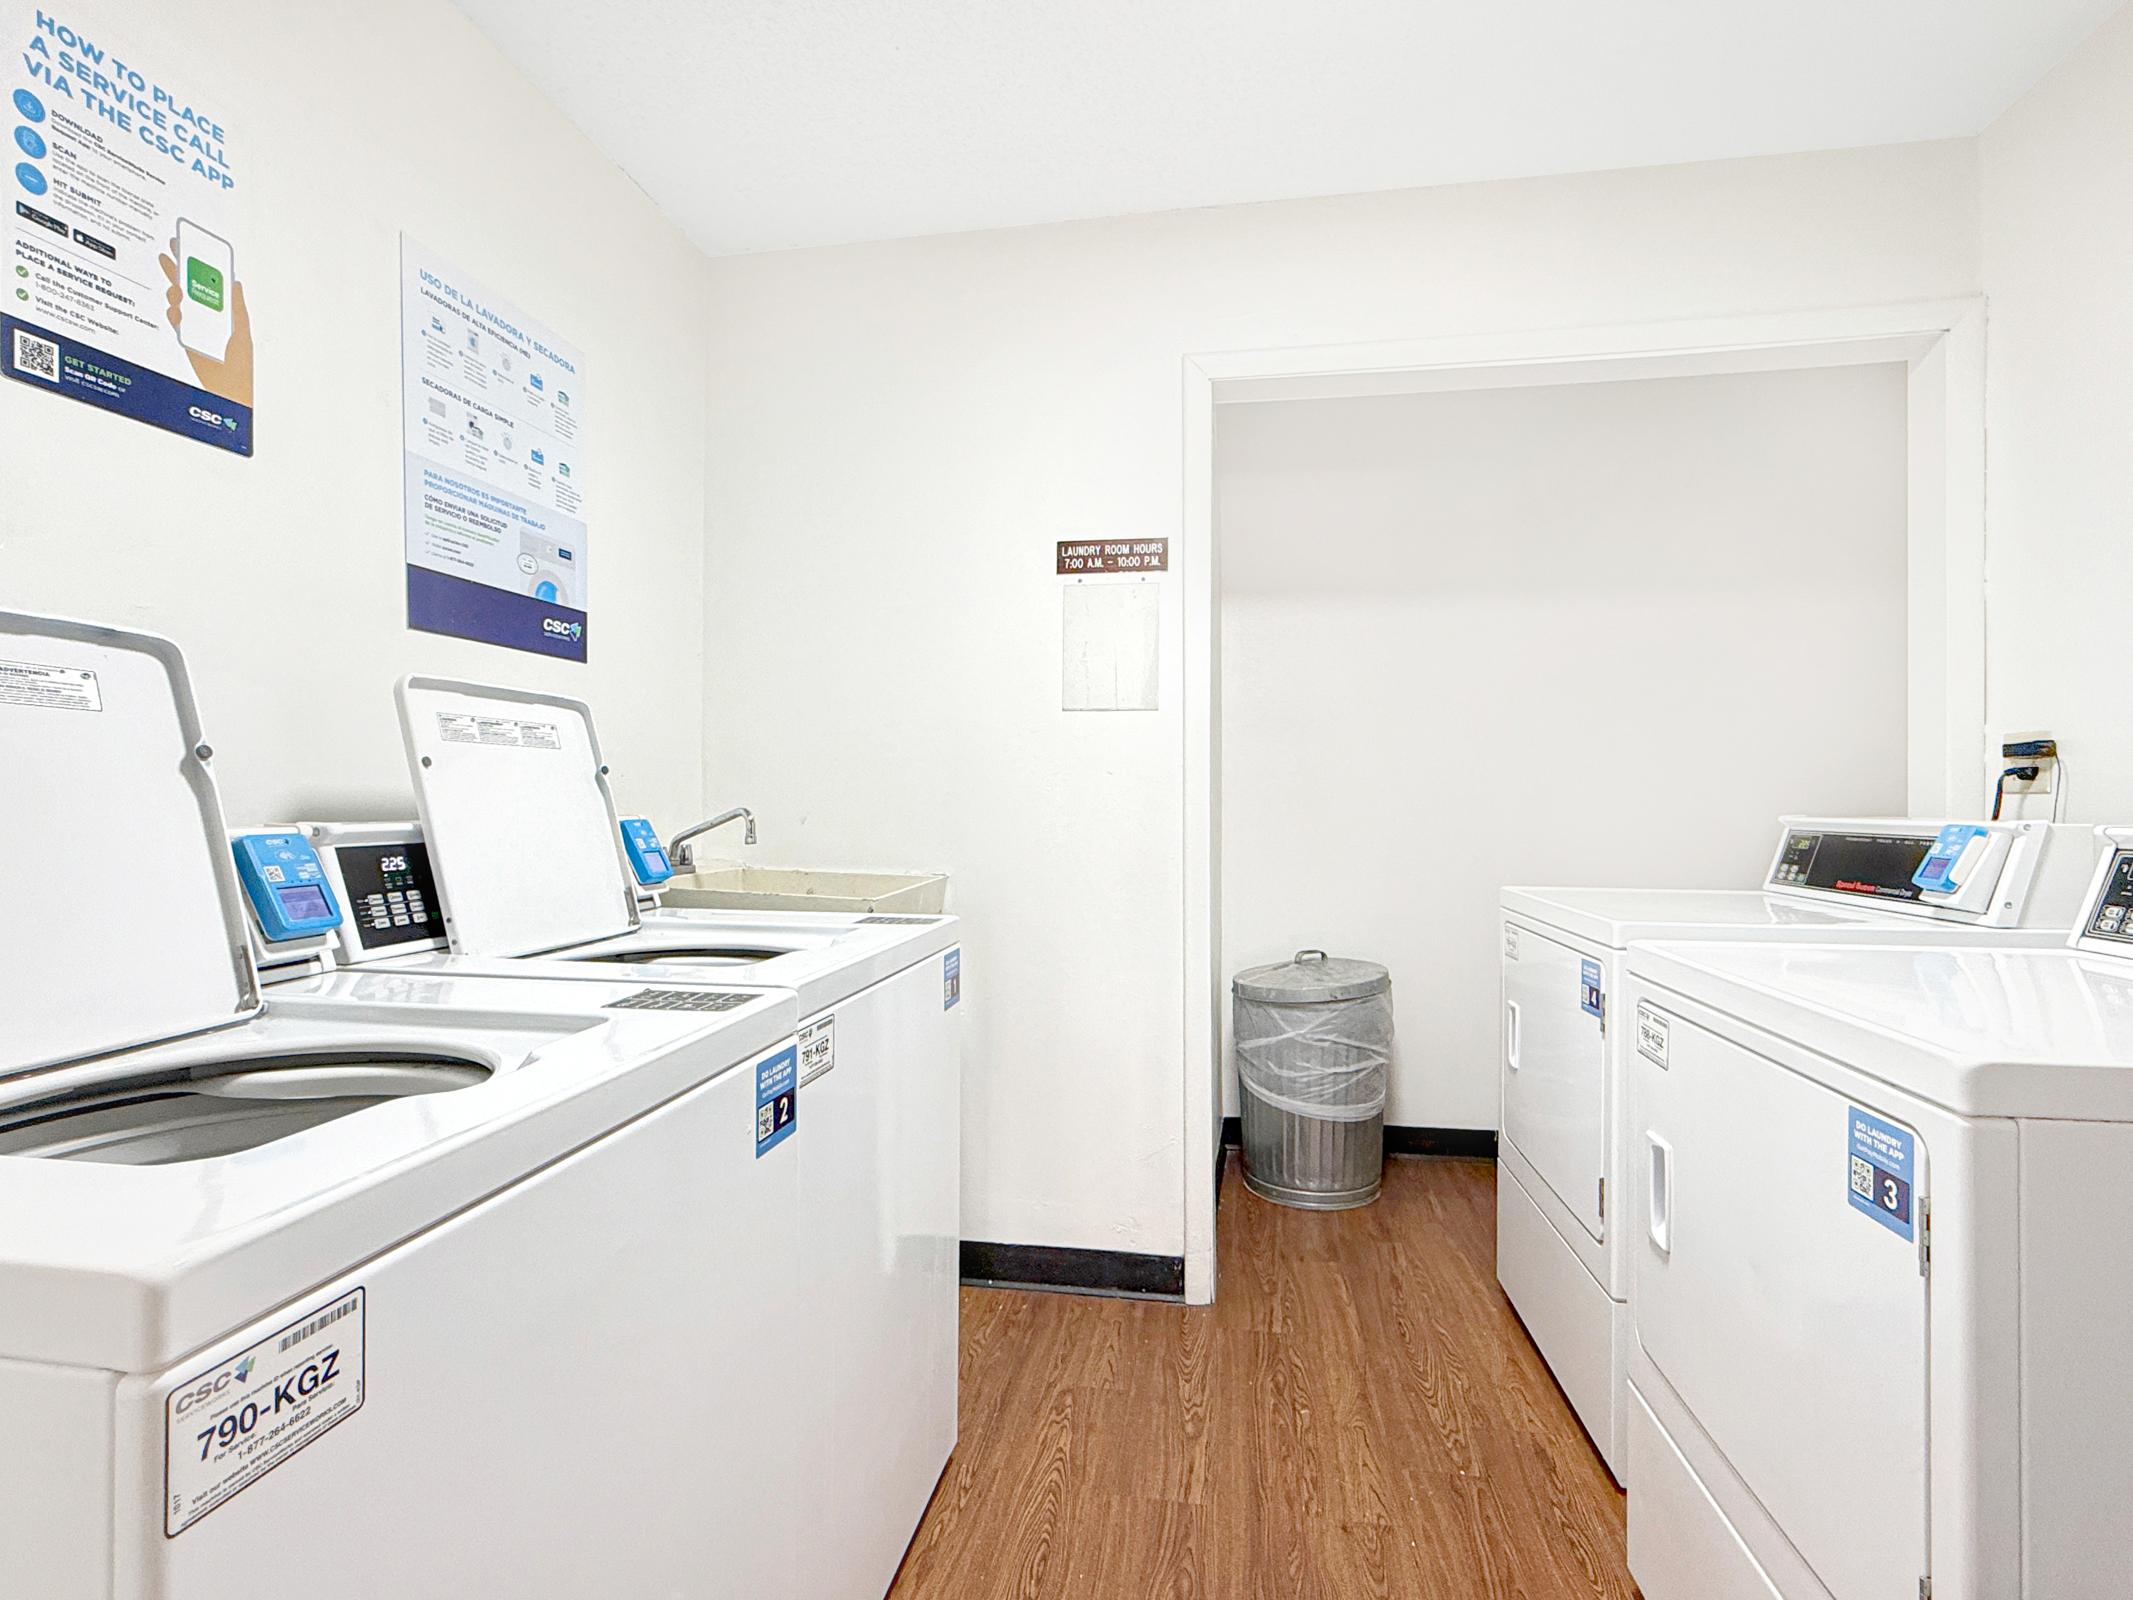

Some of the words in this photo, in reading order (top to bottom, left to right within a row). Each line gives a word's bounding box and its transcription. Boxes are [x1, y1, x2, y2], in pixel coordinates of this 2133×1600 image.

[36, 9, 104, 64] HOW
[112, 59, 146, 92] TO
[153, 85, 224, 144] PLACE
[30, 36, 50, 59] A
[59, 51, 167, 130] SERVICE
[174, 124, 230, 169] CALL
[23, 52, 74, 99] VIA
[81, 88, 132, 133] THE
[139, 126, 184, 164] CSC
[192, 159, 234, 190] APP
[51, 109, 103, 143] DOWNLOAD
[52, 141, 76, 160] SCAN
[53, 177, 67, 189] HIT
[69, 185, 101, 207] SUBMIT
[16, 238, 71, 270] ADDITIONAL
[74, 265, 97, 281] WAYS
[101, 277, 111, 287] TO
[16, 248, 45, 267] PLACE
[48, 263, 54, 271] A
[57, 267, 92, 288] SERVICE
[95, 283, 134, 307] REQUEST:
[192, 279, 220, 299] Service
[35, 272, 49, 284] Call
[52, 279, 64, 290] the
[67, 286, 102, 306] Customer
[104, 302, 132, 320] Support
[35, 295, 52, 308] Visit
[55, 303, 66, 314] the
[70, 309, 85, 321] CSC
[420, 287, 460, 316] LAVADORAS
[462, 312, 470, 322] DE
[472, 319, 486, 331] ALTA
[420, 268, 441, 289] USO
[444, 284, 458, 300] DE
[461, 294, 474, 310] LA
[476, 304, 524, 342] LAVADORA
[526, 336, 532, 345] Y
[534, 342, 575, 374] SECADORA
[64, 354, 83, 368] GET
[87, 363, 131, 386] STARTED
[64, 365, 83, 378] Scan
[84, 373, 96, 382] QR
[97, 377, 116, 390] Code
[422, 377, 461, 402] SECADORAS
[463, 398, 472, 406] DE
[473, 402, 492, 417] CARGA
[188, 406, 222, 425] CSC
[424, 469, 443, 482] PARA
[444, 477, 480, 496] NOSOTROS
[424, 494, 443, 506] CÓMO
[444, 502, 466, 515] ENVIAR
[467, 509, 479, 518] UNA
[424, 502, 433, 510] DE
[434, 505, 461, 521] SERVICIO
[1062, 546, 1101, 557] LAUNDRY
[1105, 544, 1130, 555] ROOM
[1133, 543, 1163, 554] HOURS
[1065, 558, 1083, 569] 7:00
[1087, 558, 1104, 568] A.M.
[1118, 556, 1140, 567] 10:00
[1144, 555, 1161, 566] P.M.
[543, 619, 570, 635] CSC
[381, 856, 406, 871] 225
[954, 978, 957, 993] 1
[1591, 990, 1596, 1006] 4
[802, 1038, 829, 1063] 791-KGZ
[761, 1070, 768, 1080] DO
[770, 1058, 790, 1075] LAUNDRY
[783, 1067, 792, 1079] APP
[780, 1097, 788, 1124] 2
[1854, 1130, 1872, 1146] WITH
[1873, 1138, 1888, 1154] THE
[1888, 1147, 1904, 1161] APP
[1855, 1120, 1866, 1132] DO
[1867, 1126, 1902, 1149] LAUNDRY
[1883, 1178, 1898, 1210] 3
[176, 1372, 232, 1415] CSC
[197, 1349, 340, 1462] 790-KGZ
[238, 1404, 311, 1461] 1-877-264-6622
[213, 1447, 228, 1464] For
[192, 1488, 207, 1506] Visit
[211, 1481, 220, 1493] our
[222, 1462, 248, 1486] website
